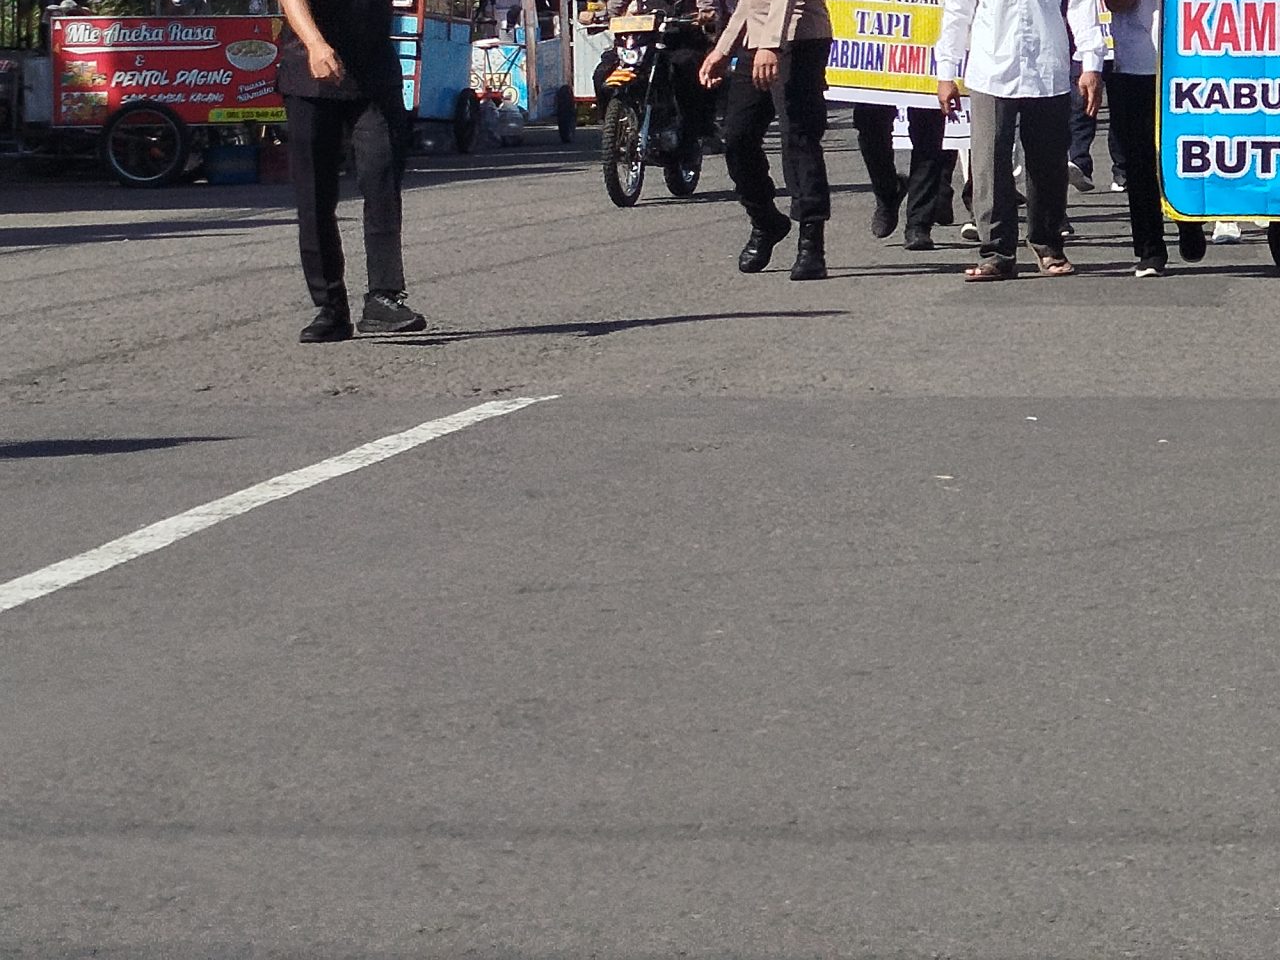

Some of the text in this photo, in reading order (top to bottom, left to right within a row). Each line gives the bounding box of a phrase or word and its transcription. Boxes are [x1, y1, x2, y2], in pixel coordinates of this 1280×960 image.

[66, 23, 215, 44] Mie Aneka Rasa
[856, 10, 911, 38] TAPI
[830, 39, 886, 72] ABDIAN
[888, 44, 927, 75] KAMI
[111, 70, 169, 87] PENTOL
[173, 69, 233, 87] DAGING
